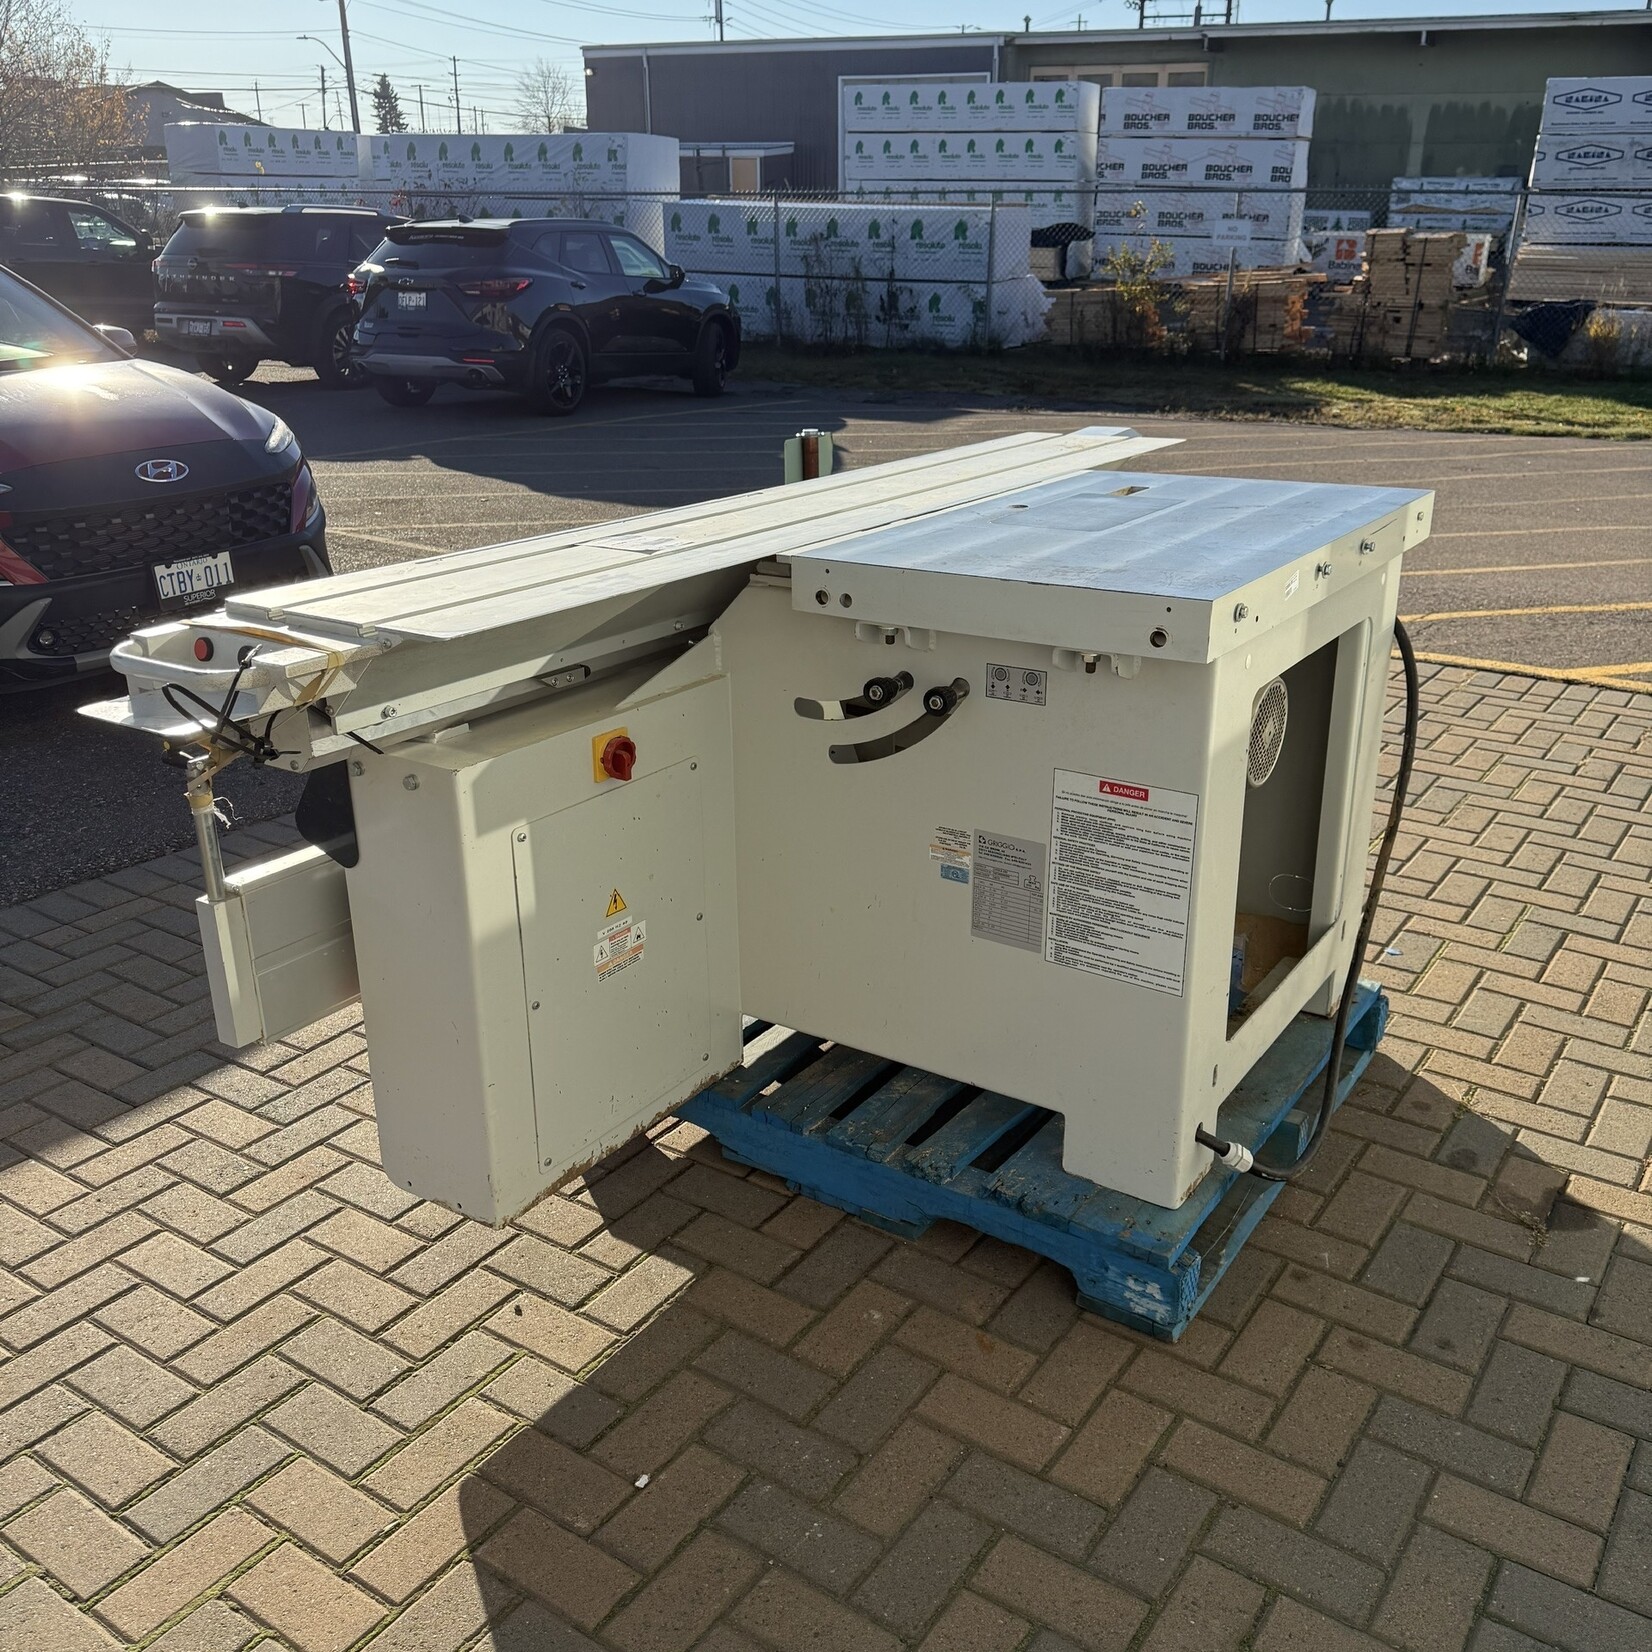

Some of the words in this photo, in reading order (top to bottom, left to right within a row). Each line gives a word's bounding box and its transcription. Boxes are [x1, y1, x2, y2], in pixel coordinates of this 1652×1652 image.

[1253, 122, 1284, 130] BROS.
[1142, 163, 1188, 172] BOUCHER
[1206, 164, 1252, 173] BOUCHER
[1205, 173, 1234, 181] BROS.
[1158, 212, 1204, 220] BOUCHER
[176, 558, 208, 570] ONTARIO
[159, 569, 194, 597] CTBY
[204, 562, 232, 587] 011
[184, 589, 216, 602] SUPERIOR
[1113, 786, 1145, 798] DANGER
[988, 839, 1015, 850] GRIGGIO
